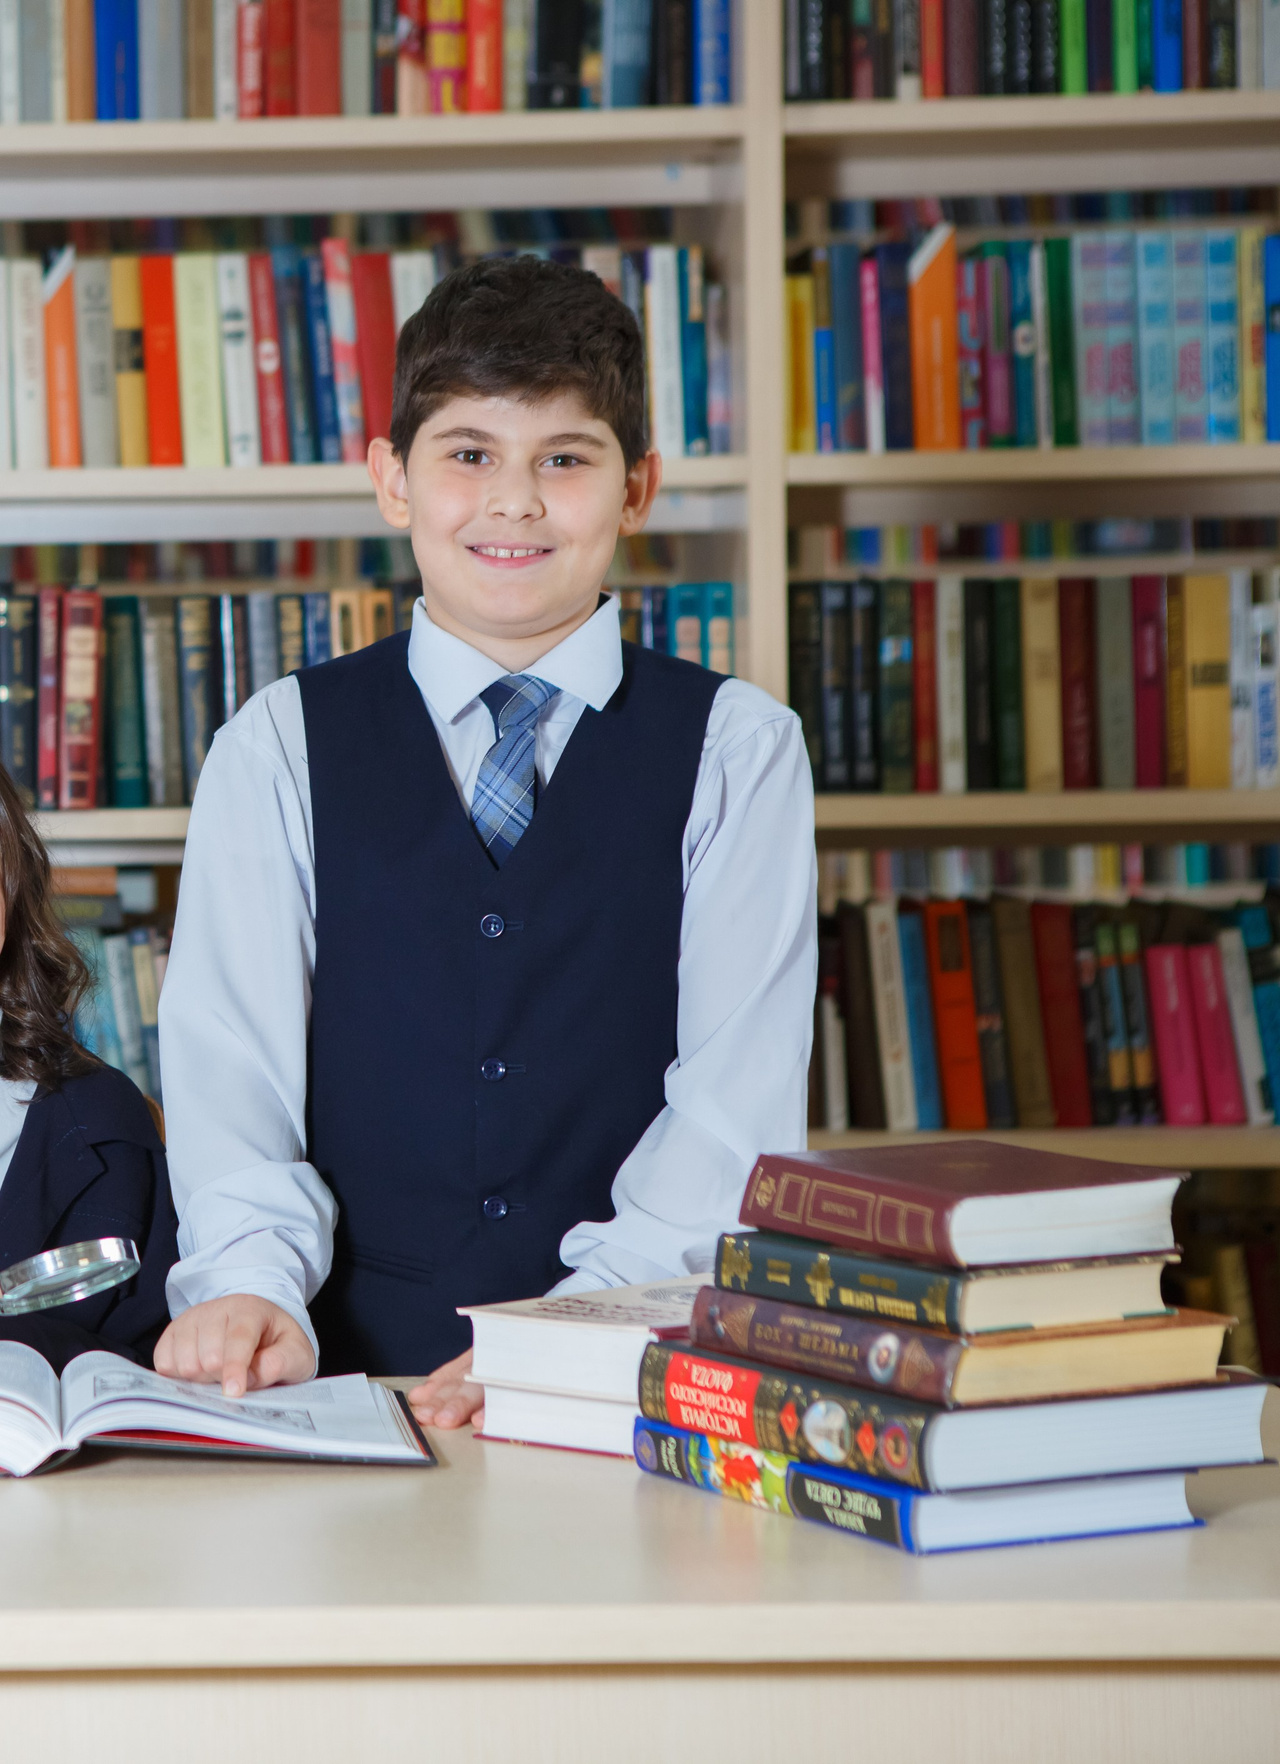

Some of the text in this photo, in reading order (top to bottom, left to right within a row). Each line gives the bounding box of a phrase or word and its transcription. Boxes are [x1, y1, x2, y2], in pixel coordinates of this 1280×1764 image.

[690, 1362, 734, 1395] ФЛОТА
[669, 1384, 747, 1419] РОССИЙСКОГО
[679, 1404, 742, 1439] ИСТОРИЯ
[803, 1477, 883, 1522] ЧУДЕС СВЕТА
[822, 1504, 868, 1535] КНИГА
